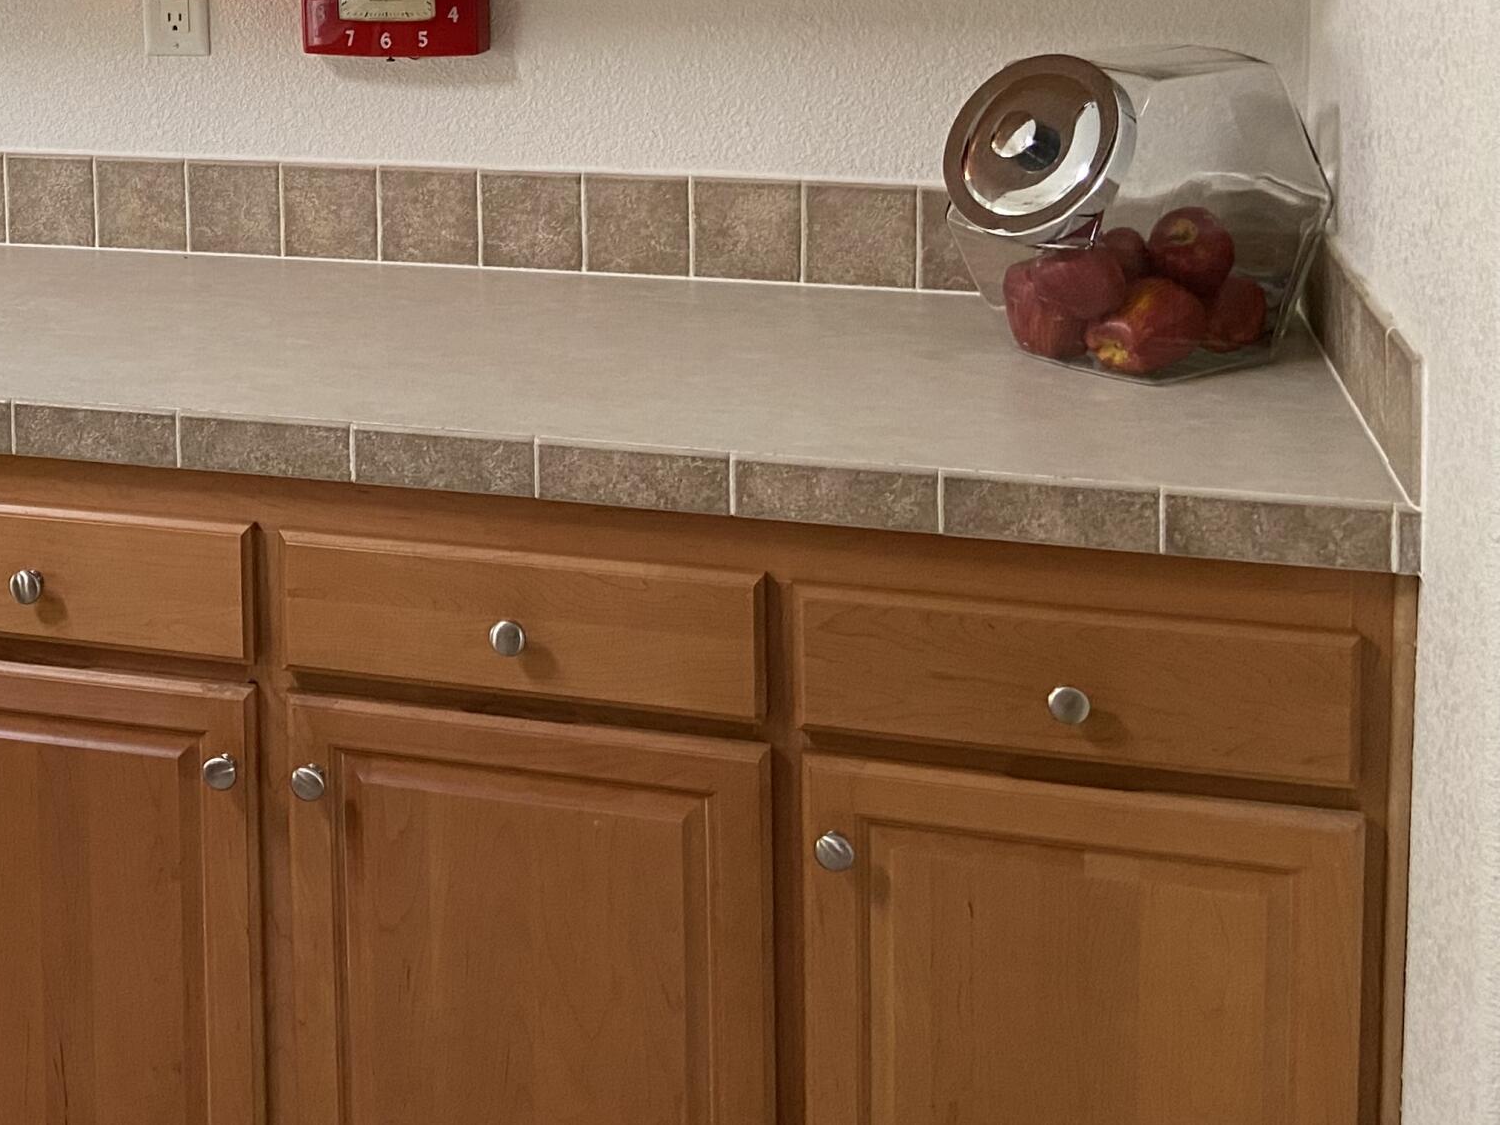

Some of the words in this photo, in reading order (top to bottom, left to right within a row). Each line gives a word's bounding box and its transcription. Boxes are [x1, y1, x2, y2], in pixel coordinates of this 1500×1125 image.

[447, 6, 459, 23] 4
[345, 30, 355, 47] 7
[380, 32, 392, 49] 6
[418, 31, 428, 47] 5
